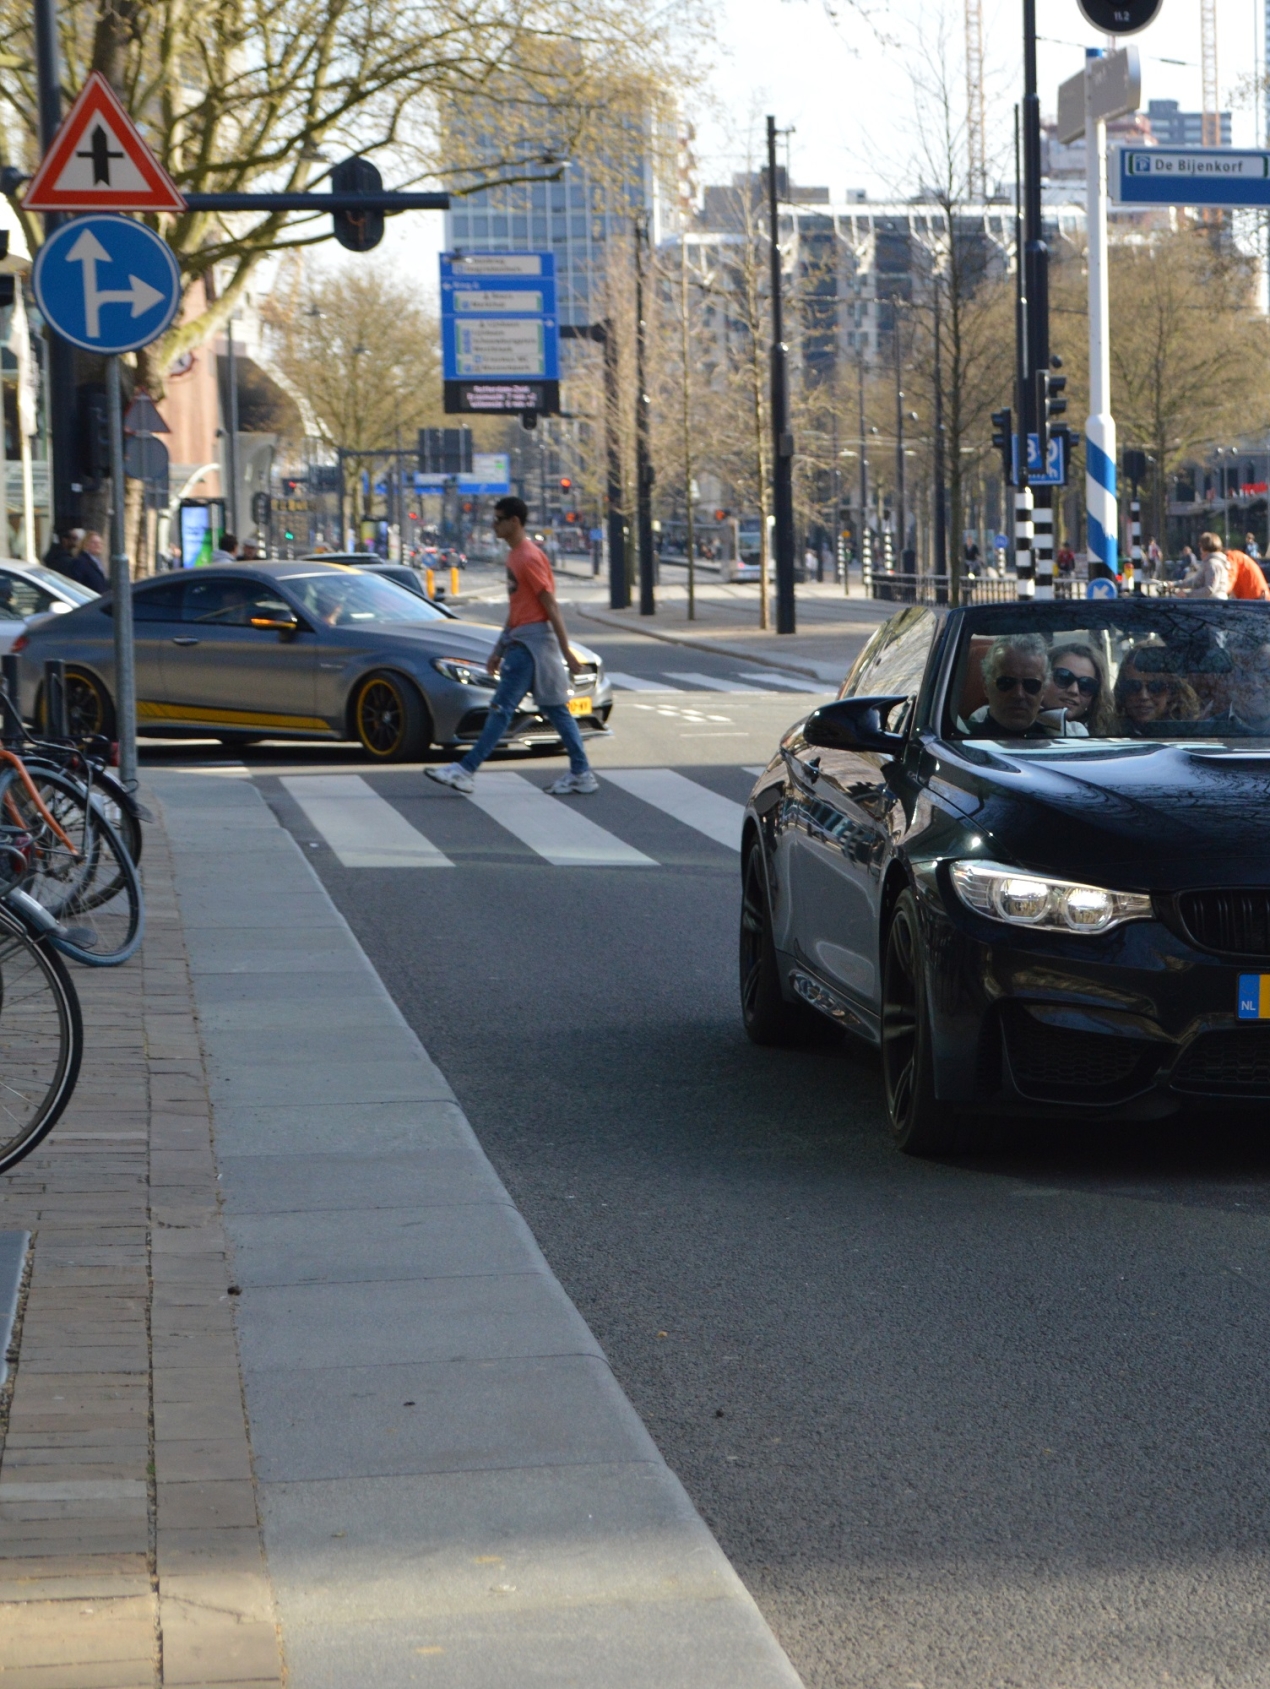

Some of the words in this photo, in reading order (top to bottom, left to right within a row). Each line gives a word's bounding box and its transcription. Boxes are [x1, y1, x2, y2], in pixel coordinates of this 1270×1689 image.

[1114, 11, 1130, 21] 11.2
[1155, 158, 1173, 171] De
[1178, 158, 1244, 175] Bijenkorf
[1241, 1001, 1256, 1011] NL
